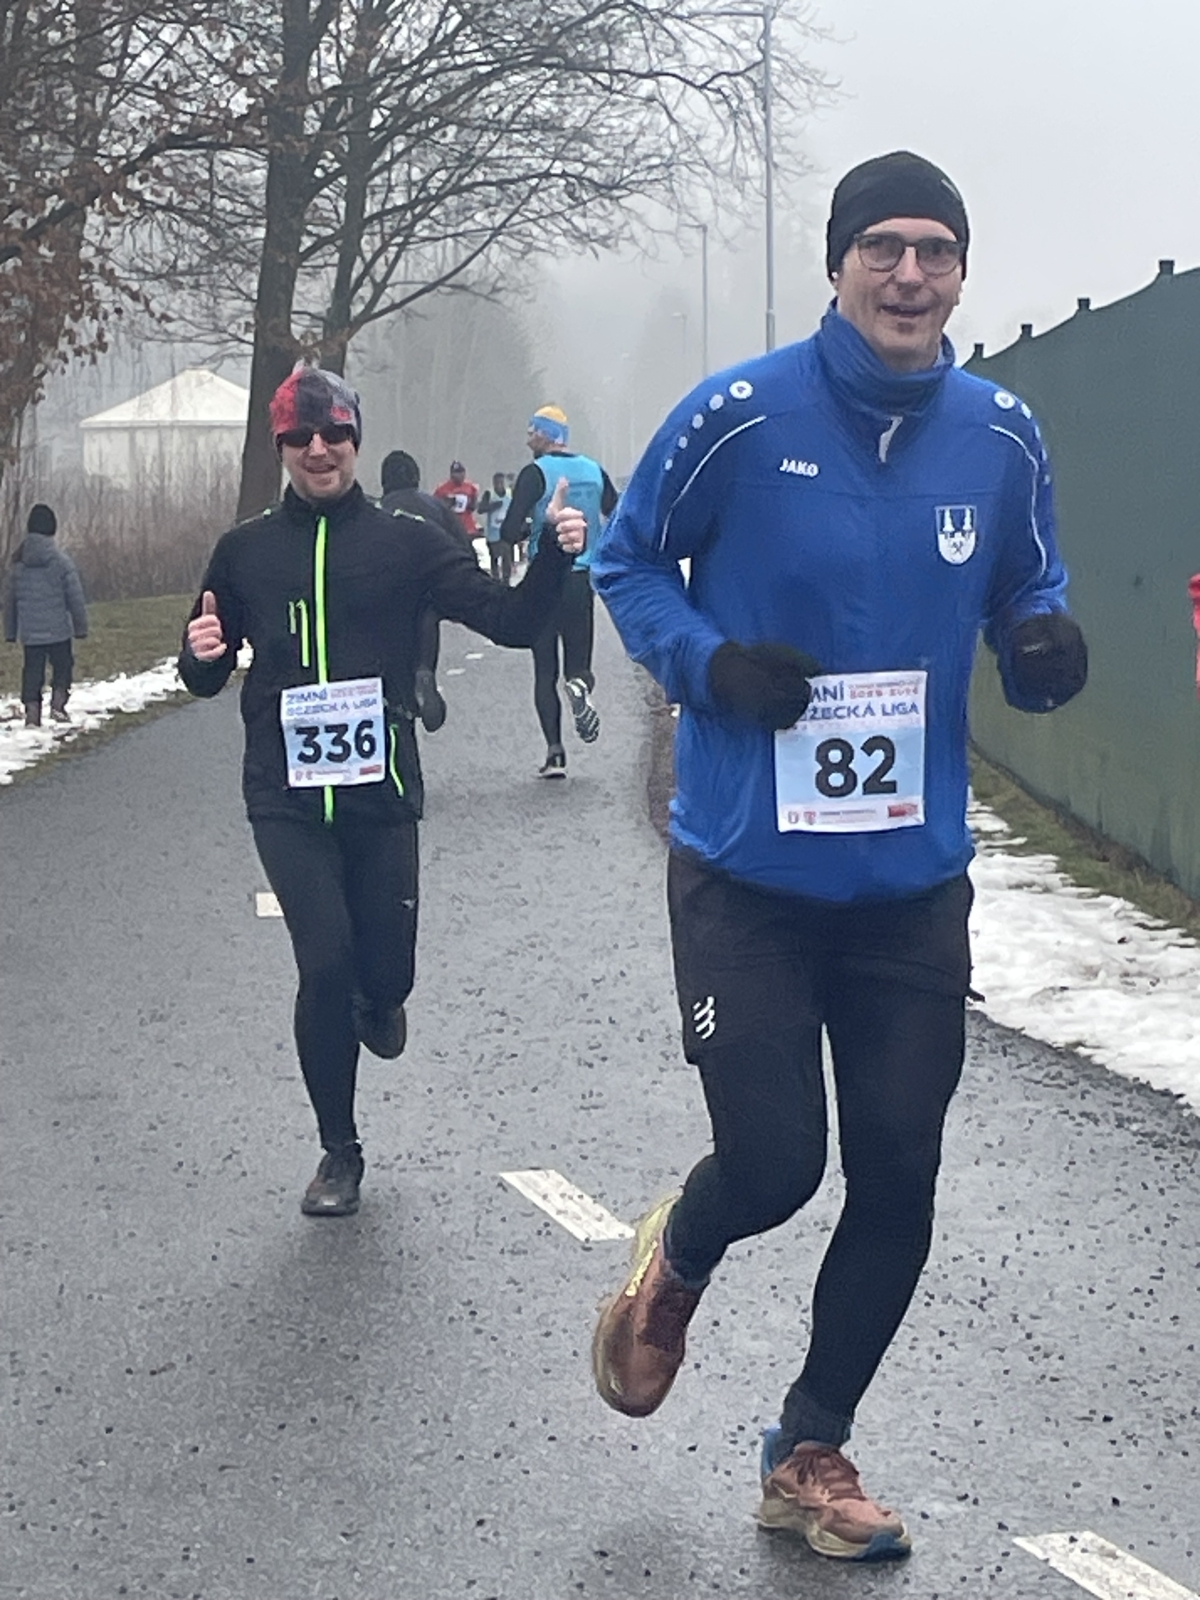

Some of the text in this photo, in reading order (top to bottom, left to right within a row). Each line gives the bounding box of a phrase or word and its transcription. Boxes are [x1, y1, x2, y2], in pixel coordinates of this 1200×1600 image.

[779, 458, 819, 477] JAKO
[881, 701, 920, 716] LIGA
[294, 719, 376, 764] 336
[815, 735, 898, 798] 82
